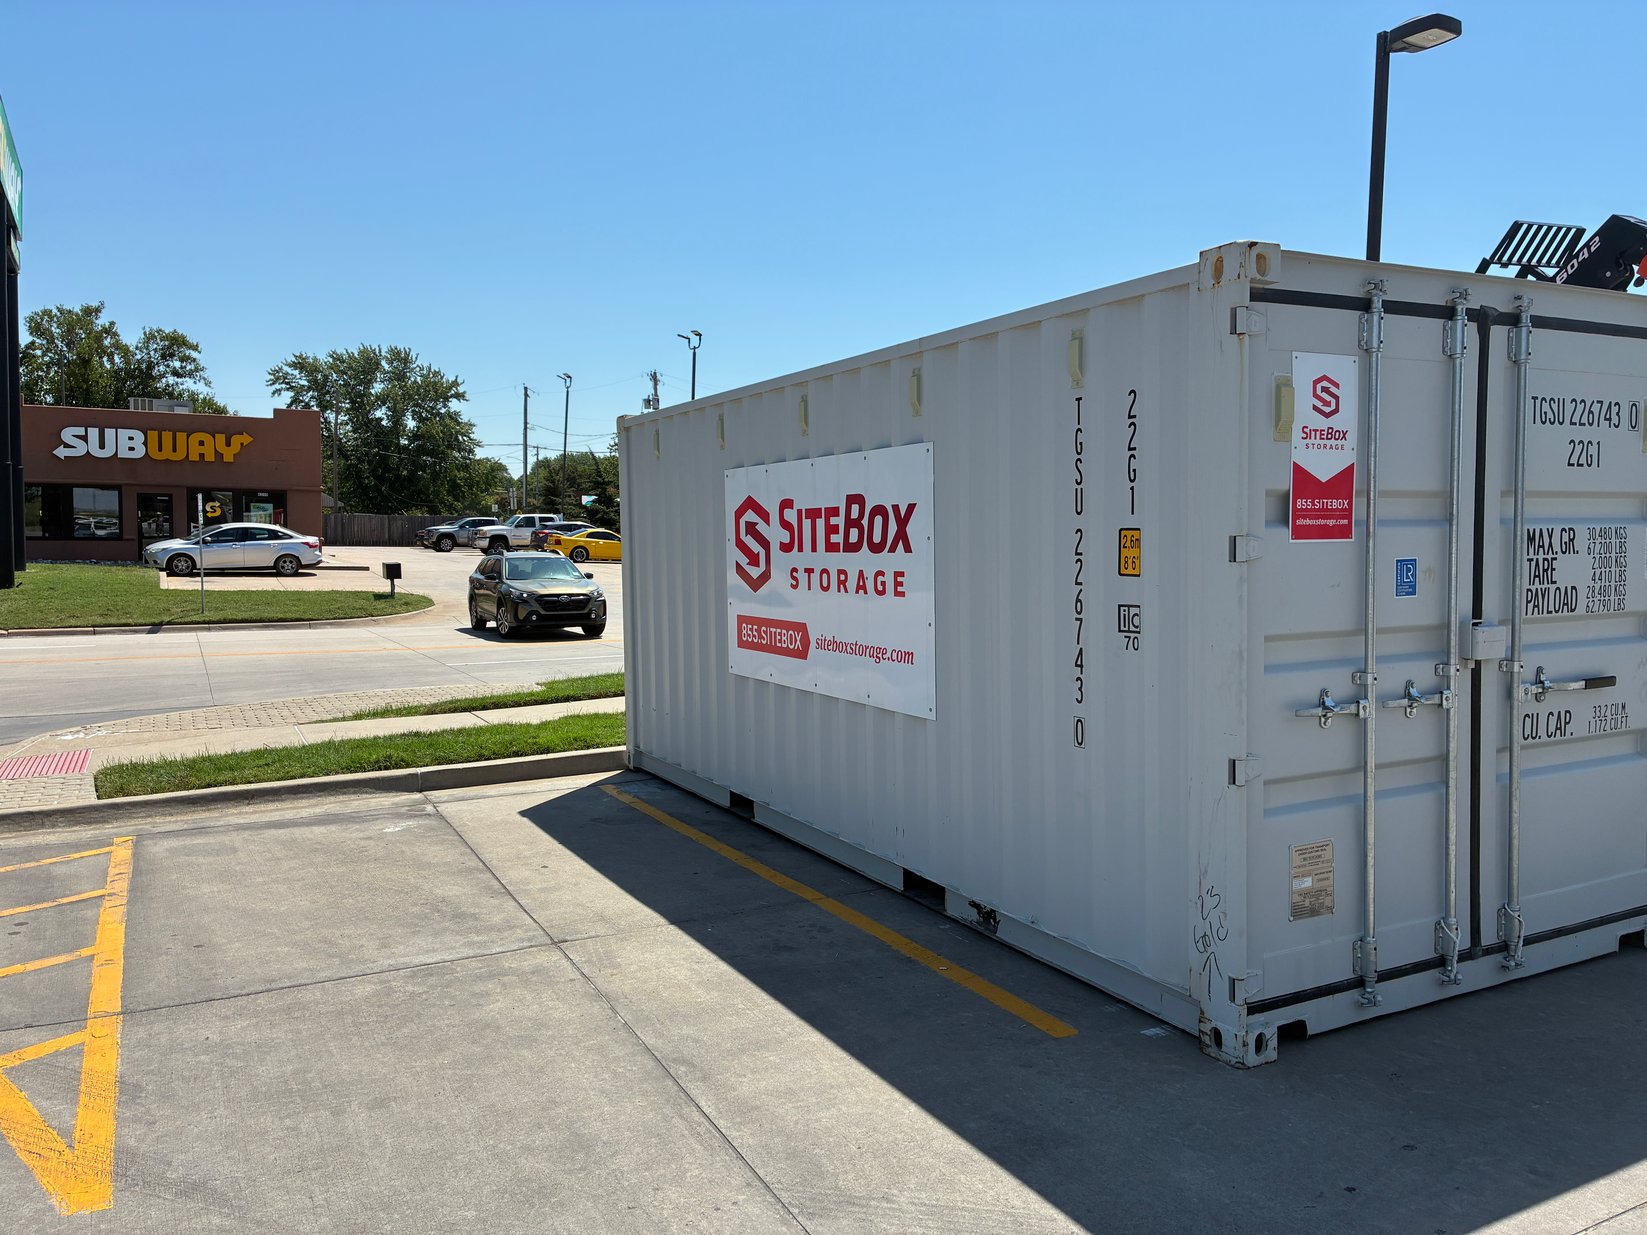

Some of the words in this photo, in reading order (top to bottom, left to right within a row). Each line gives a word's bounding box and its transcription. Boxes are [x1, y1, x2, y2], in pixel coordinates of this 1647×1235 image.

[1555, 235, 1601, 284] 6042
[1531, 396, 1566, 426] TGSU
[1569, 398, 1621, 429] 226743
[1629, 402, 1638, 430] 0
[52, 426, 254, 463] SUBWAY
[1074, 396, 1084, 516] TGSU
[1127, 389, 1137, 516] 22G1
[1305, 442, 1345, 451] STORAGE
[1567, 439, 1601, 468] 22G1
[1296, 498, 1349, 509] 855.SITEBOX
[1296, 518, 1349, 526] siteboxstorage.com
[1587, 526, 1613, 542] 30.480
[1614, 526, 1628, 540] KGS
[1587, 540, 1613, 556] 67.200
[1614, 540, 1628, 555] LBS
[789, 566, 907, 599] STORAGE
[1526, 556, 1558, 586] TARE
[1591, 555, 1613, 570] 2.000
[1614, 554, 1628, 569] KGS
[1591, 569, 1613, 584] 4.410
[1614, 569, 1627, 584] LBS
[1525, 585, 1578, 617] PAYLOAD
[1586, 584, 1612, 600] 28.480
[1613, 583, 1627, 598] KGS
[1585, 598, 1612, 614] 62.790
[1613, 597, 1626, 612] LBS
[1074, 528, 1084, 705] 226743
[741, 623, 803, 651] 855.SITEBOX
[815, 633, 915, 666] siteboxstorage.com
[1123, 635, 1139, 652] 70
[1522, 713, 1542, 741] CU.
[1546, 709, 1574, 739] CAP.
[1592, 704, 1608, 720] 33.2
[1588, 718, 1608, 734] 1.172
